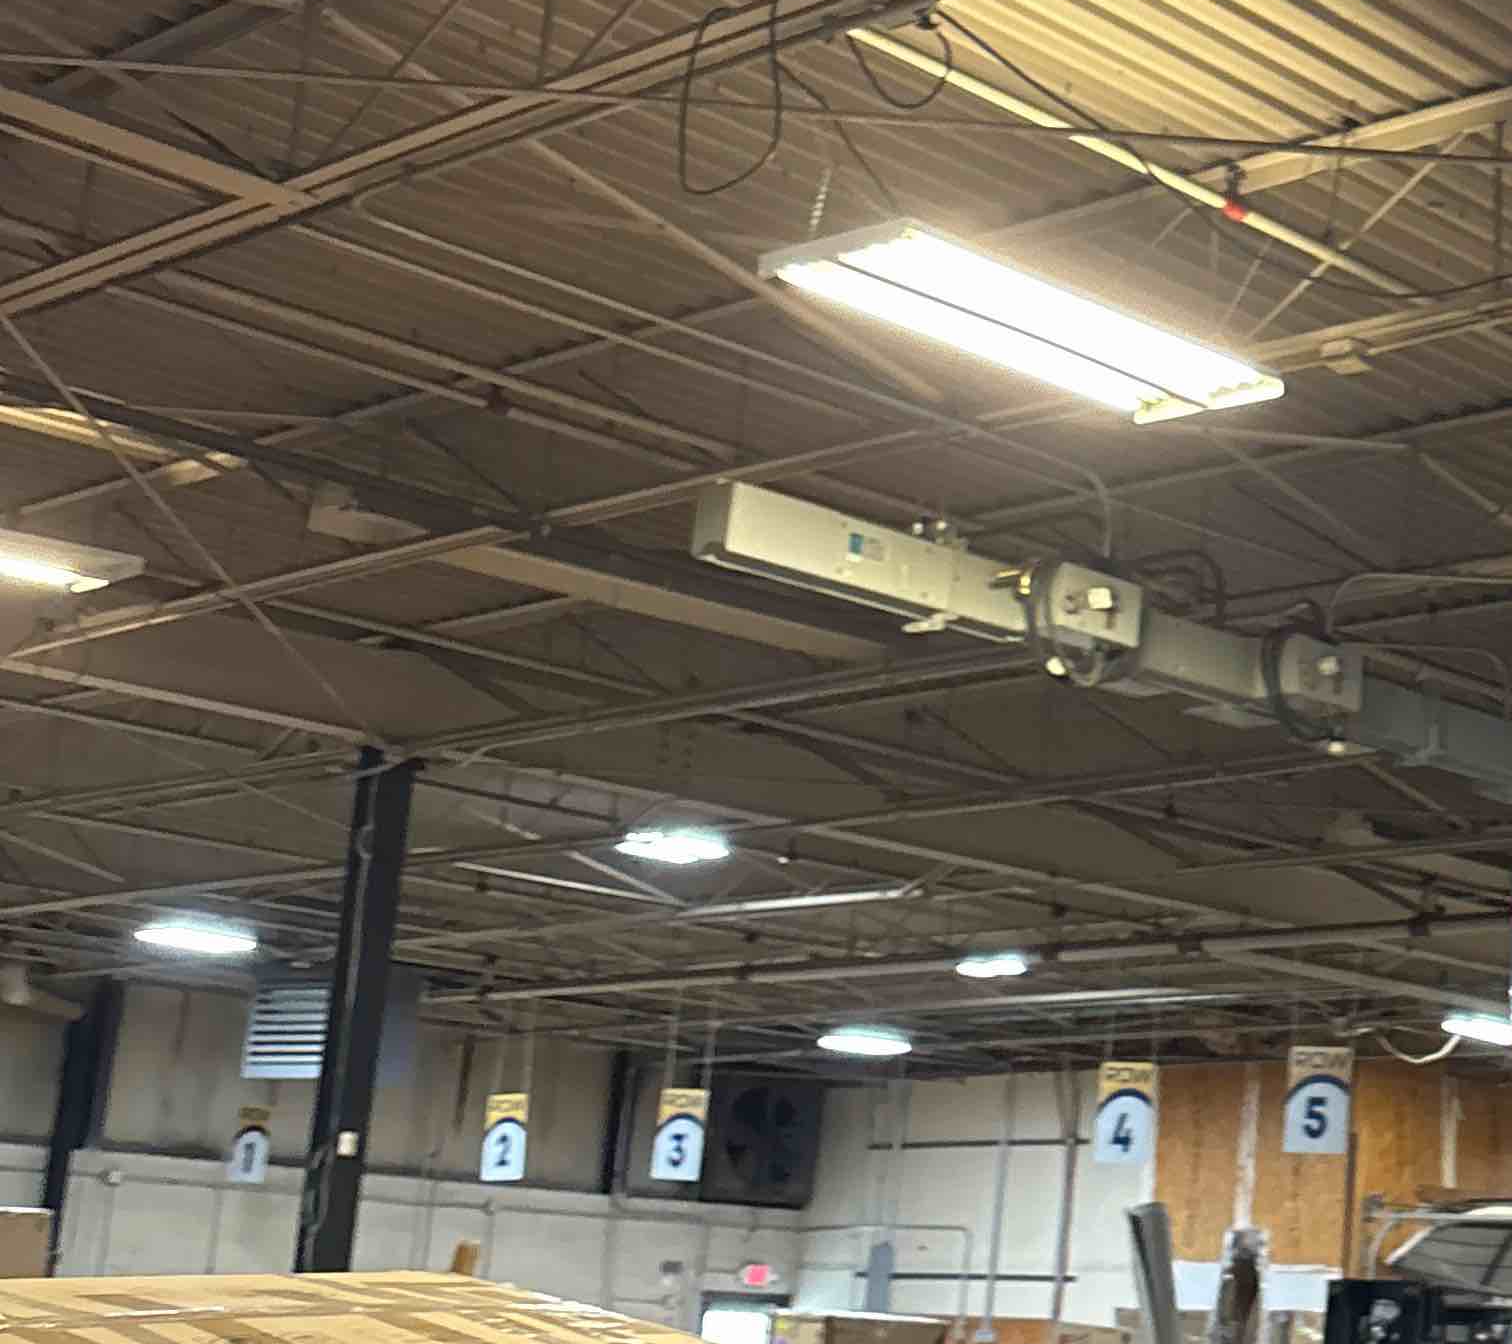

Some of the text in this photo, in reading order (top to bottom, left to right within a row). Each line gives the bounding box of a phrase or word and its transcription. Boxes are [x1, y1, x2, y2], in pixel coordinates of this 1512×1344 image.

[1109, 1112, 1133, 1153] 4
[1302, 1096, 1328, 1140] 5
[494, 1132, 512, 1168] 2
[668, 1133, 688, 1168] 3
